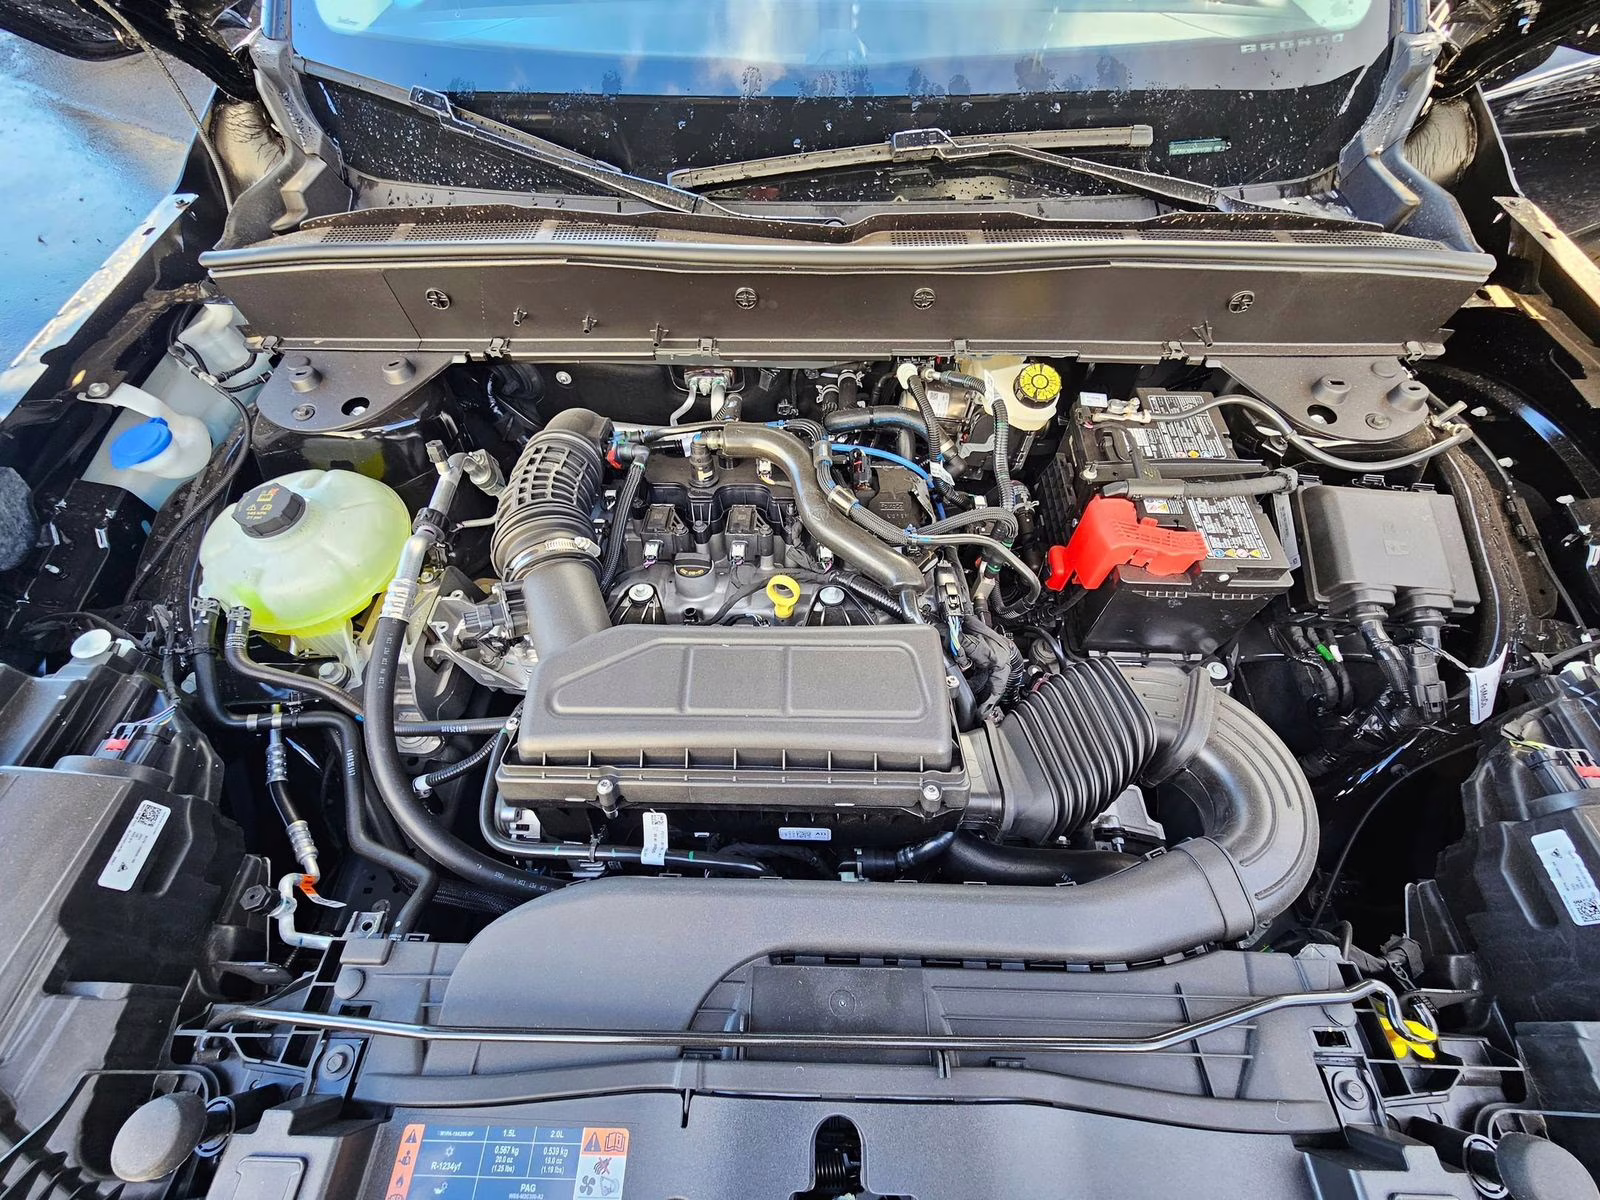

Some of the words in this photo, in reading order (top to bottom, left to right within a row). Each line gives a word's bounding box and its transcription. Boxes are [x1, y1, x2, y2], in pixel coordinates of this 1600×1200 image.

[1240, 33, 1344, 53] BRONCO
[503, 1128, 516, 1137] 1.5L
[550, 1130, 565, 1139] 2.0L
[511, 1146, 520, 1157] kg
[560, 1147, 569, 1158] kg
[431, 1161, 461, 1173] R-1234yf
[520, 1183, 537, 1193] PAG
